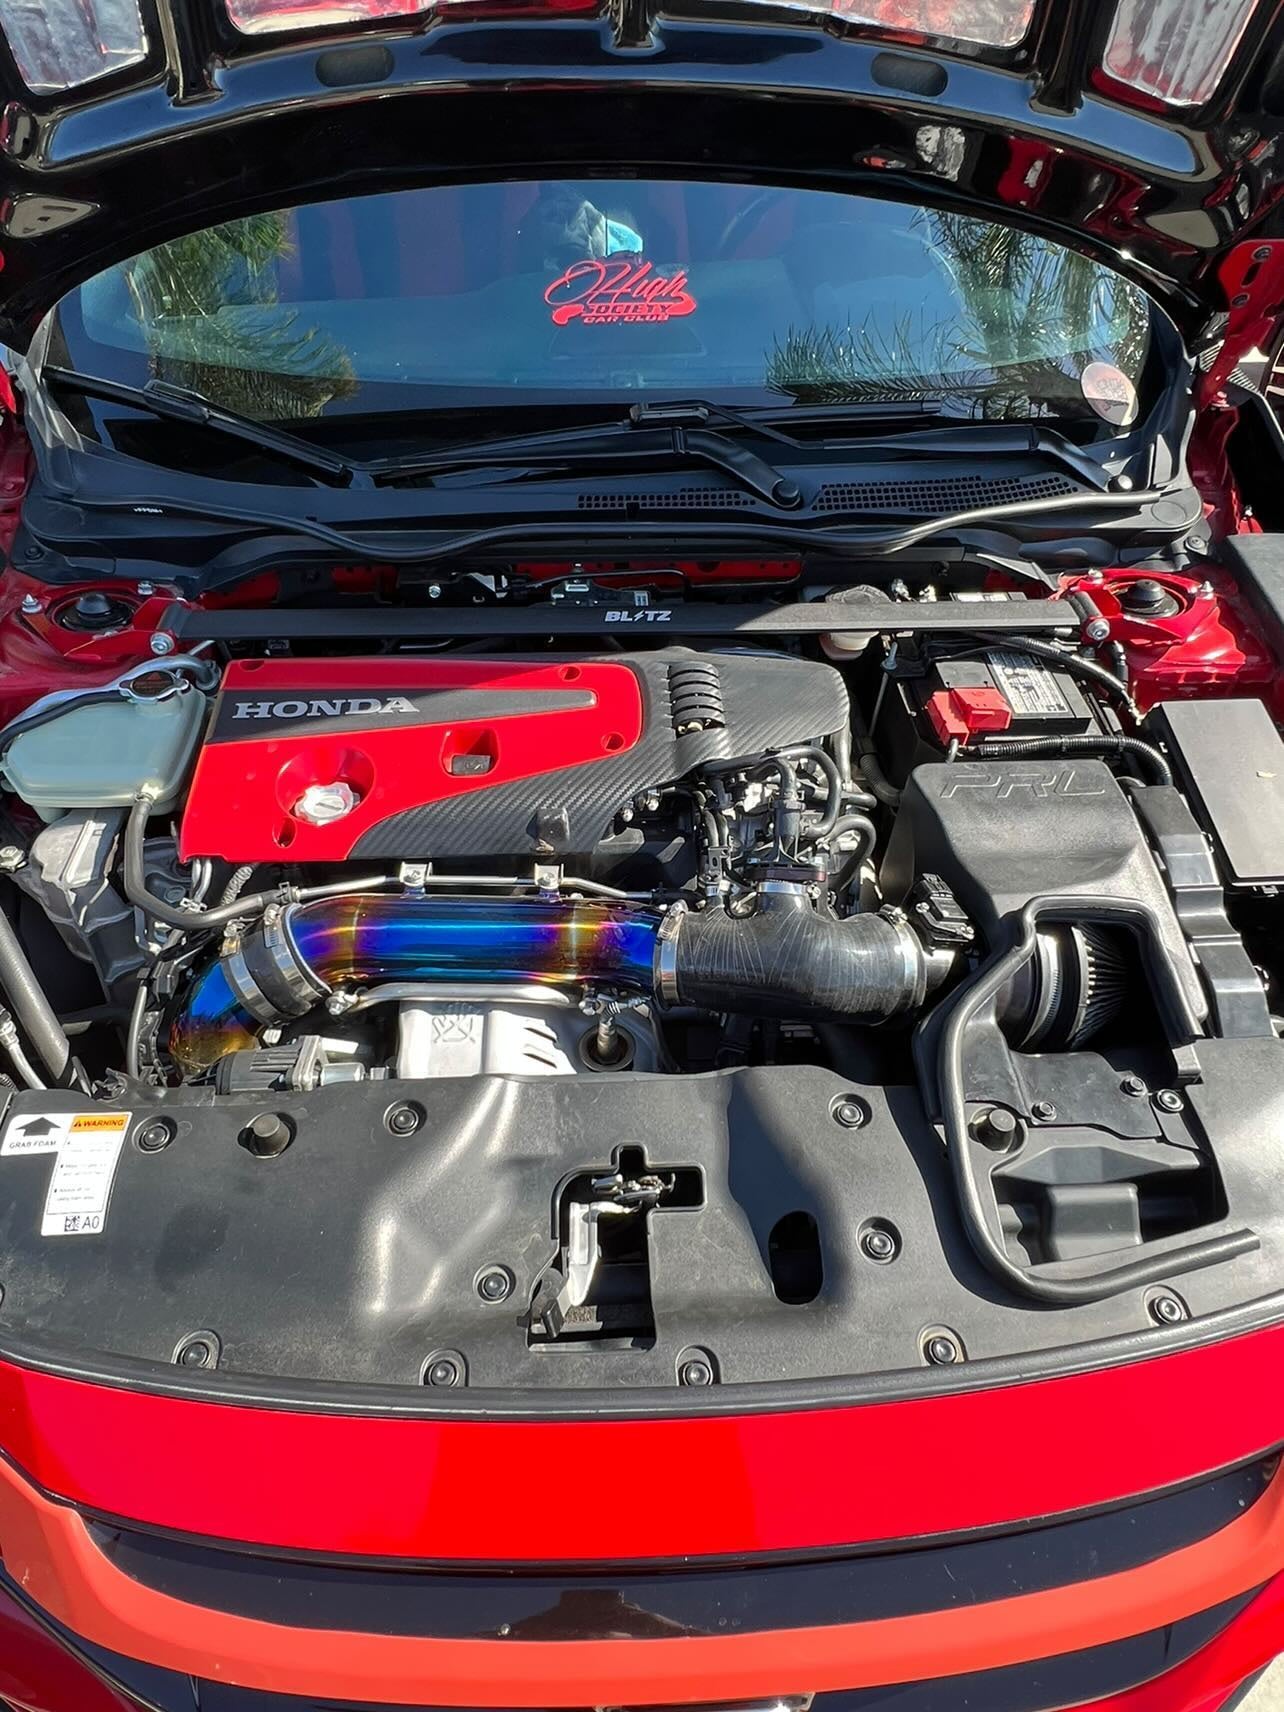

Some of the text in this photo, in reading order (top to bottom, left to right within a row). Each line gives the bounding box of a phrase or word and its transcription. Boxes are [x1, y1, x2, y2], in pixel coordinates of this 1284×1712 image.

[544, 260, 688, 304] High
[584, 303, 672, 315] SOCIETY
[583, 314, 669, 324] CAR CLUB
[605, 610, 672, 622] BLITZ
[232, 696, 420, 719] HONDA
[940, 770, 1106, 798] PRL
[83, 1119, 125, 1128] WARNING
